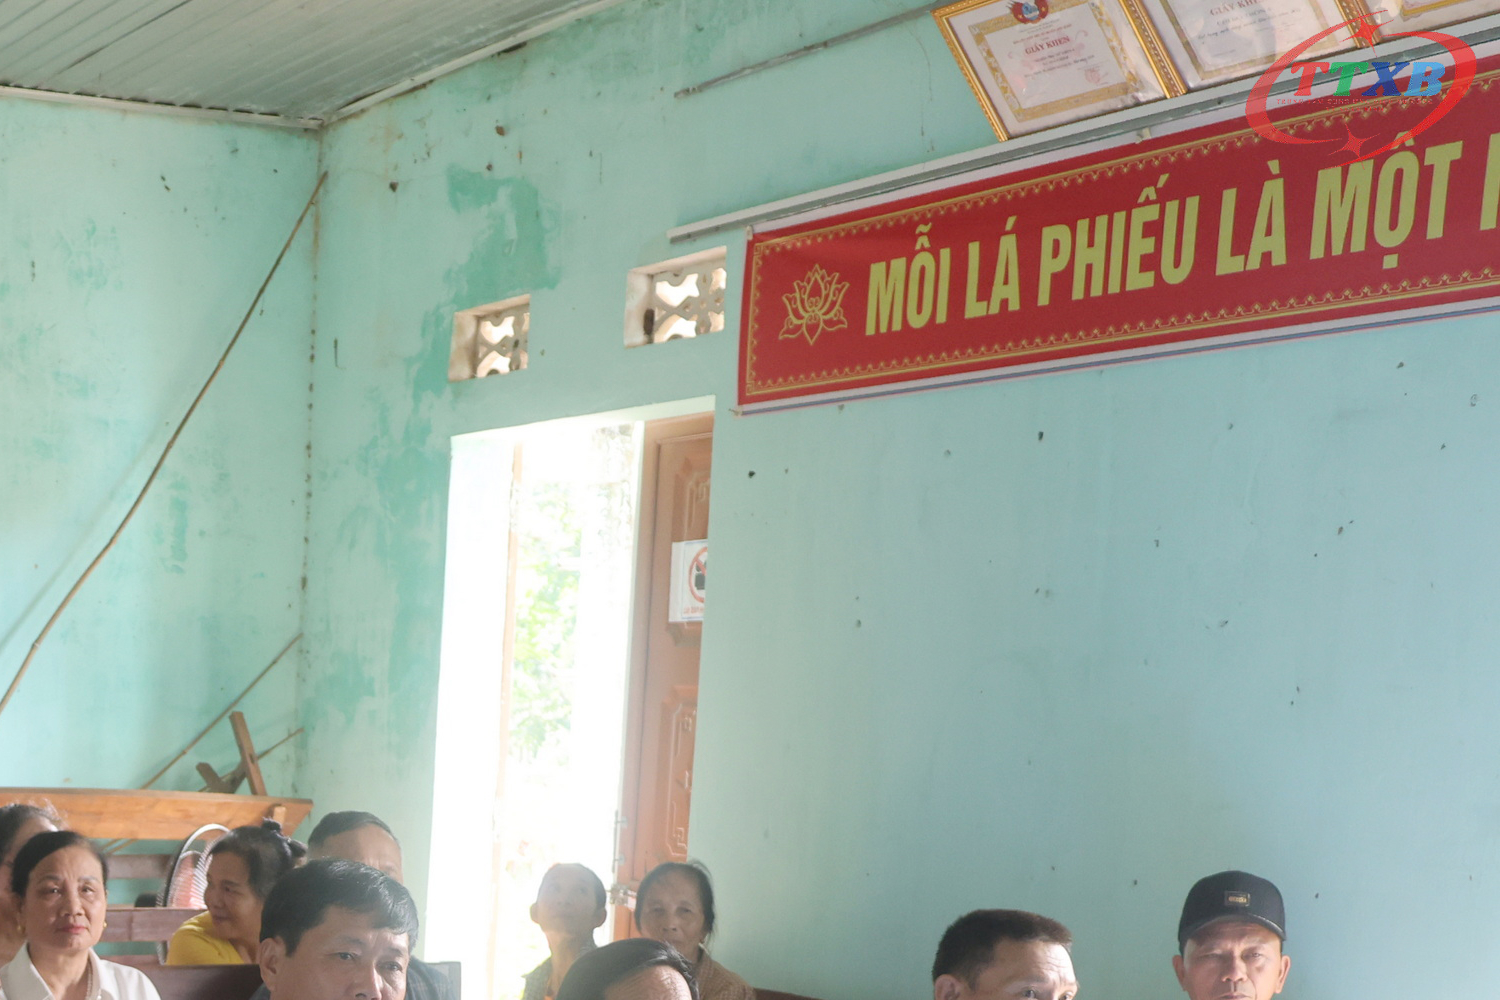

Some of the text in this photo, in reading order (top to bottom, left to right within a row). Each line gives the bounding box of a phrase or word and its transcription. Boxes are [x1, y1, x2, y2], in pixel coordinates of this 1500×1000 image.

[865, 221, 951, 336] MỖI
[964, 215, 1021, 319] LÁ
[1037, 172, 1200, 307] PHIẾU
[1215, 159, 1287, 276] LÀ
[1309, 130, 1464, 270] MỘT
